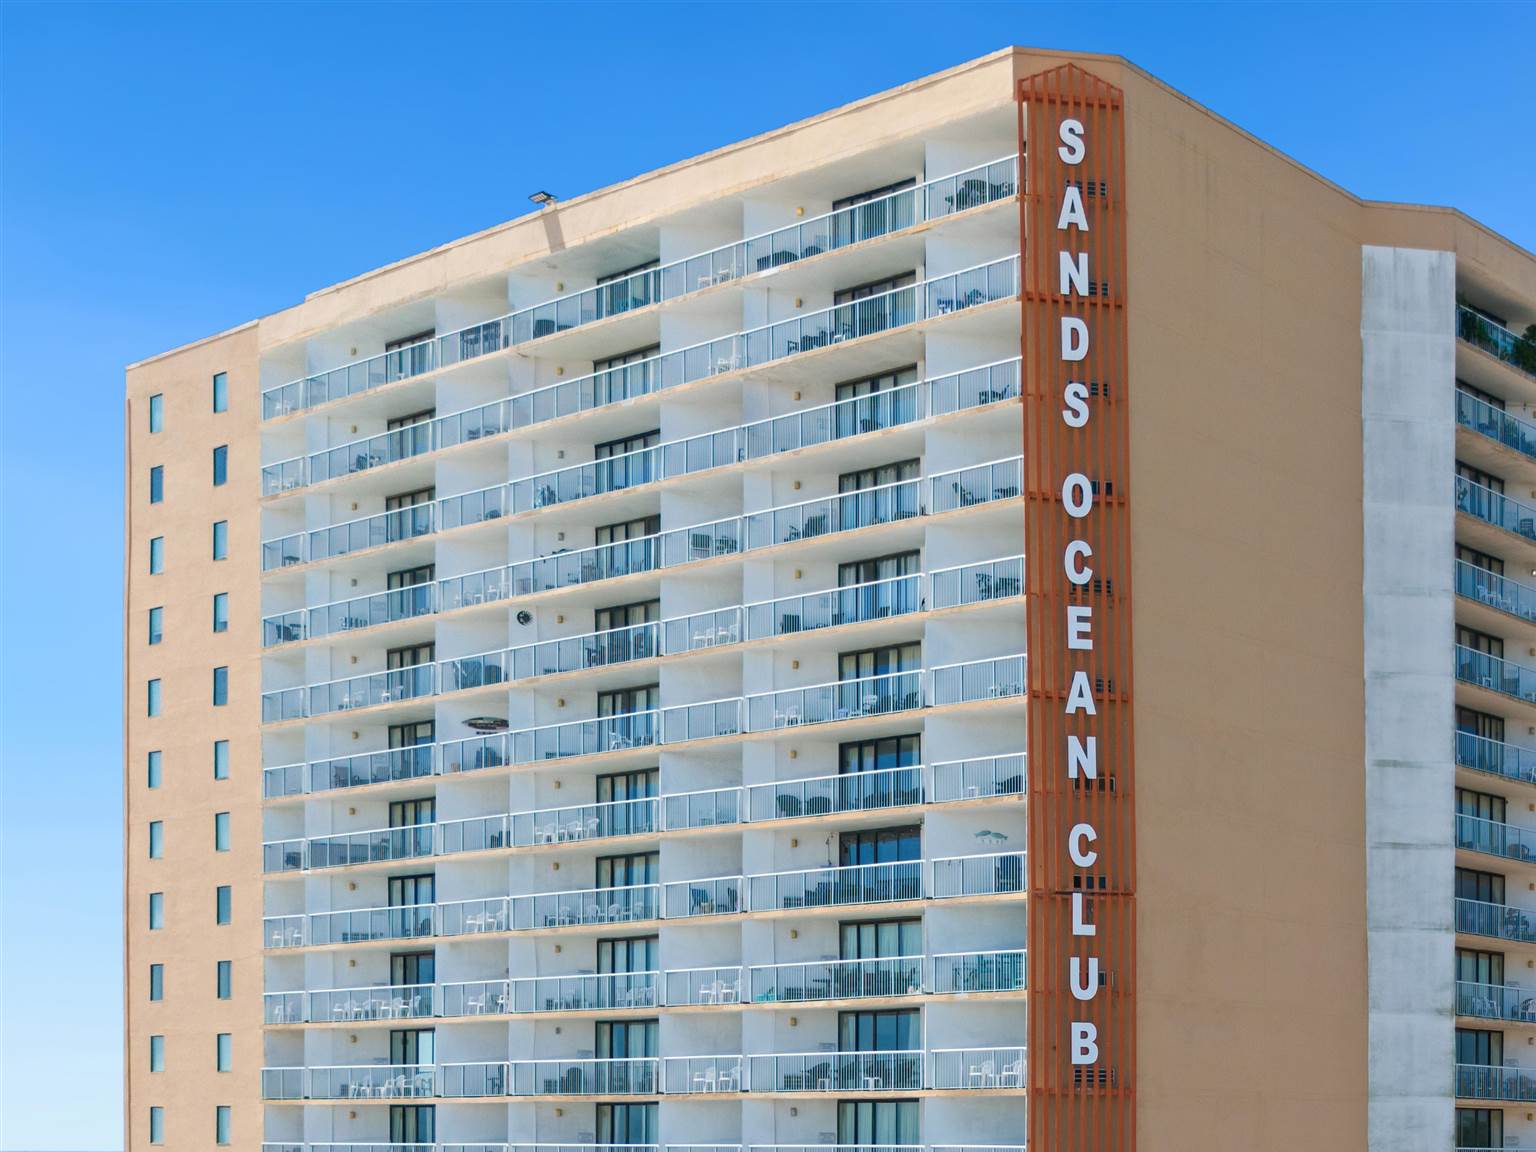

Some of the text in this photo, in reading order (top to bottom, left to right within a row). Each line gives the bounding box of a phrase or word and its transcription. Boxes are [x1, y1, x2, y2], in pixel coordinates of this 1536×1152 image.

[1057, 119, 1099, 1065] SANDS OCEAN CLUB
